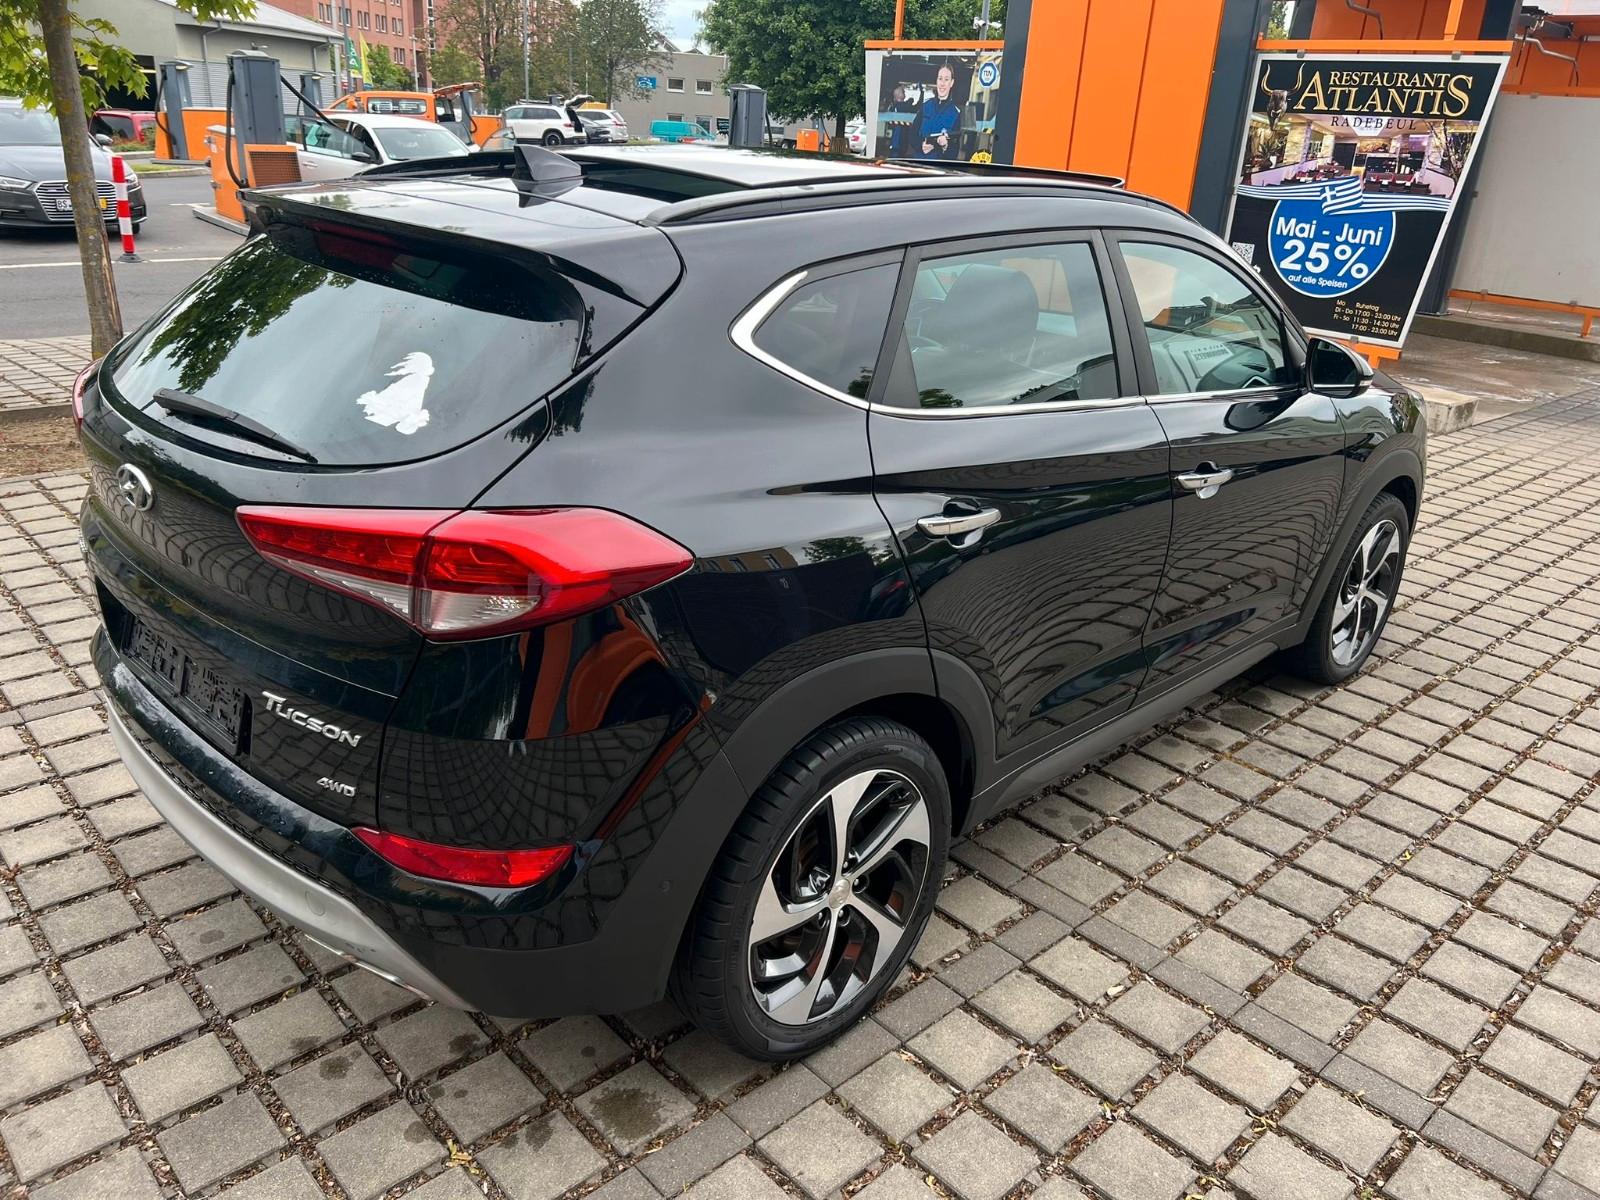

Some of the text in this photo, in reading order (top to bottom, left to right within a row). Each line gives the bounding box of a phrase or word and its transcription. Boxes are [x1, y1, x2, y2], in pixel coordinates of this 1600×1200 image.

[1328, 71, 1450, 88] RESTAURANT
[1292, 70, 1474, 117] ATLANTIS
[1331, 116, 1417, 131] RADEBEUL
[1275, 216, 1317, 239] Mai
[1335, 223, 1384, 246] Juni
[1279, 239, 1369, 279] 25%
[1287, 274, 1348, 289] auf alle Speisen
[1356, 302, 1379, 312] Ruhetag
[262, 691, 362, 747] TUCSON
[316, 777, 356, 797] 4WD
